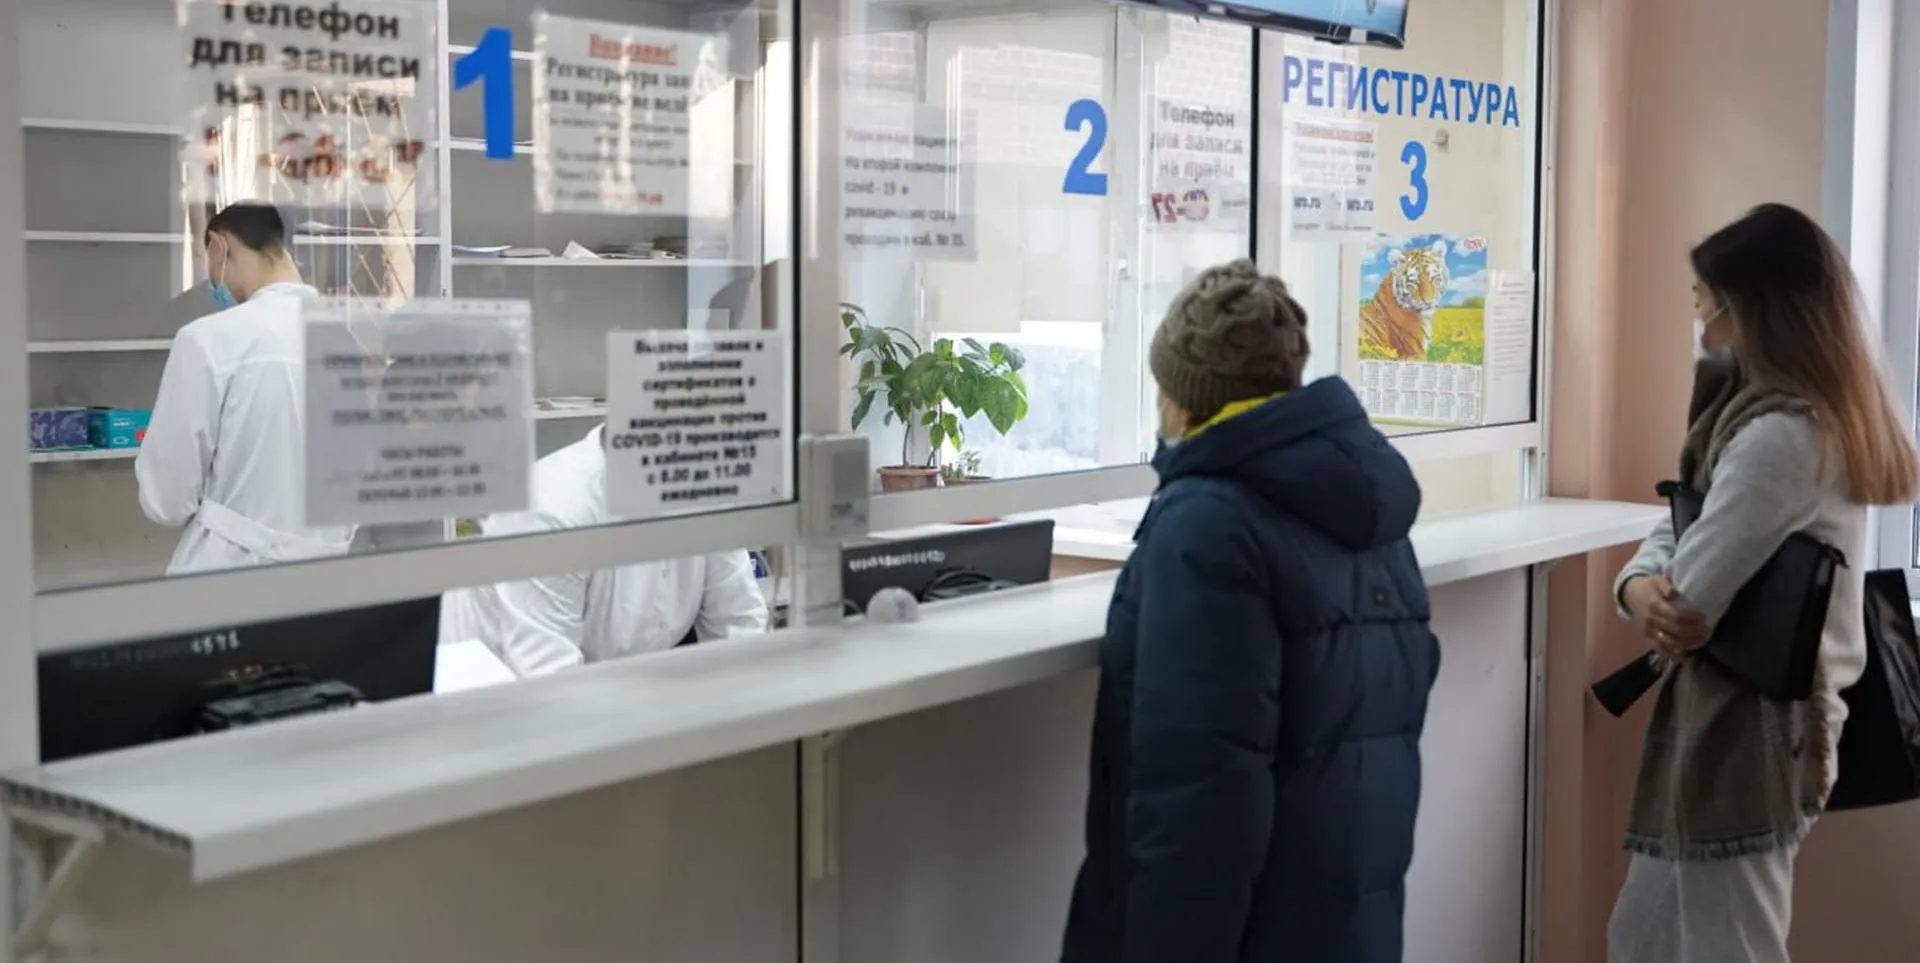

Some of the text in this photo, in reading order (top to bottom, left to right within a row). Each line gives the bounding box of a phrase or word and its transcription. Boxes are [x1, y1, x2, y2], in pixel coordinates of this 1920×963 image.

[222, 0, 399, 40] Телефон
[190, 37, 420, 79] для записи
[215, 81, 264, 106] на
[454, 28, 514, 159] 1
[1283, 55, 1519, 127] РЕГИСТРАТУРА
[1159, 100, 1234, 131] Телефон
[1062, 98, 1108, 196] 2
[1400, 141, 1428, 221] 3
[612, 432, 681, 449] COVID-19
